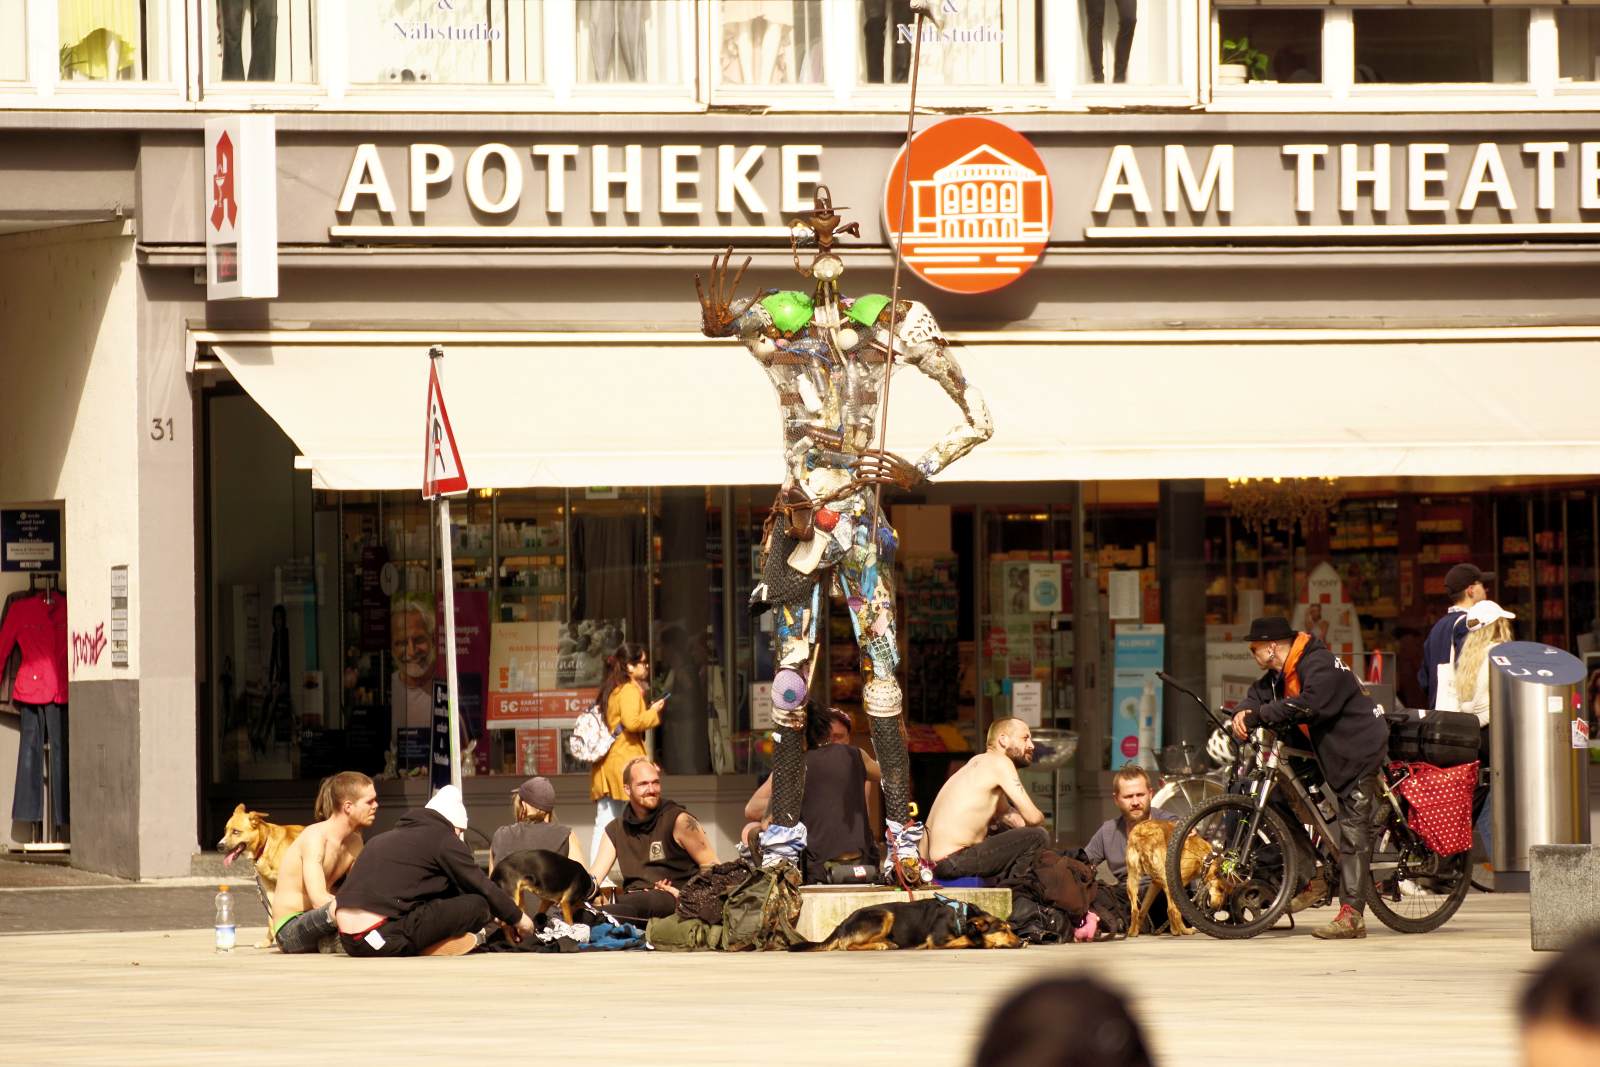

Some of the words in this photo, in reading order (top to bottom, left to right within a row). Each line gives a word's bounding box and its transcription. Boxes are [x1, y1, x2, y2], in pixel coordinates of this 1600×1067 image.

[393, 22, 501, 40] Nähstudio
[335, 143, 824, 213] APOTHEKE
[1092, 143, 1235, 213] AM
[150, 417, 174, 441] 31
[500, 700, 519, 713] 5€
[564, 699, 580, 712] 1€
[1032, 782, 1072, 793] Eucin
